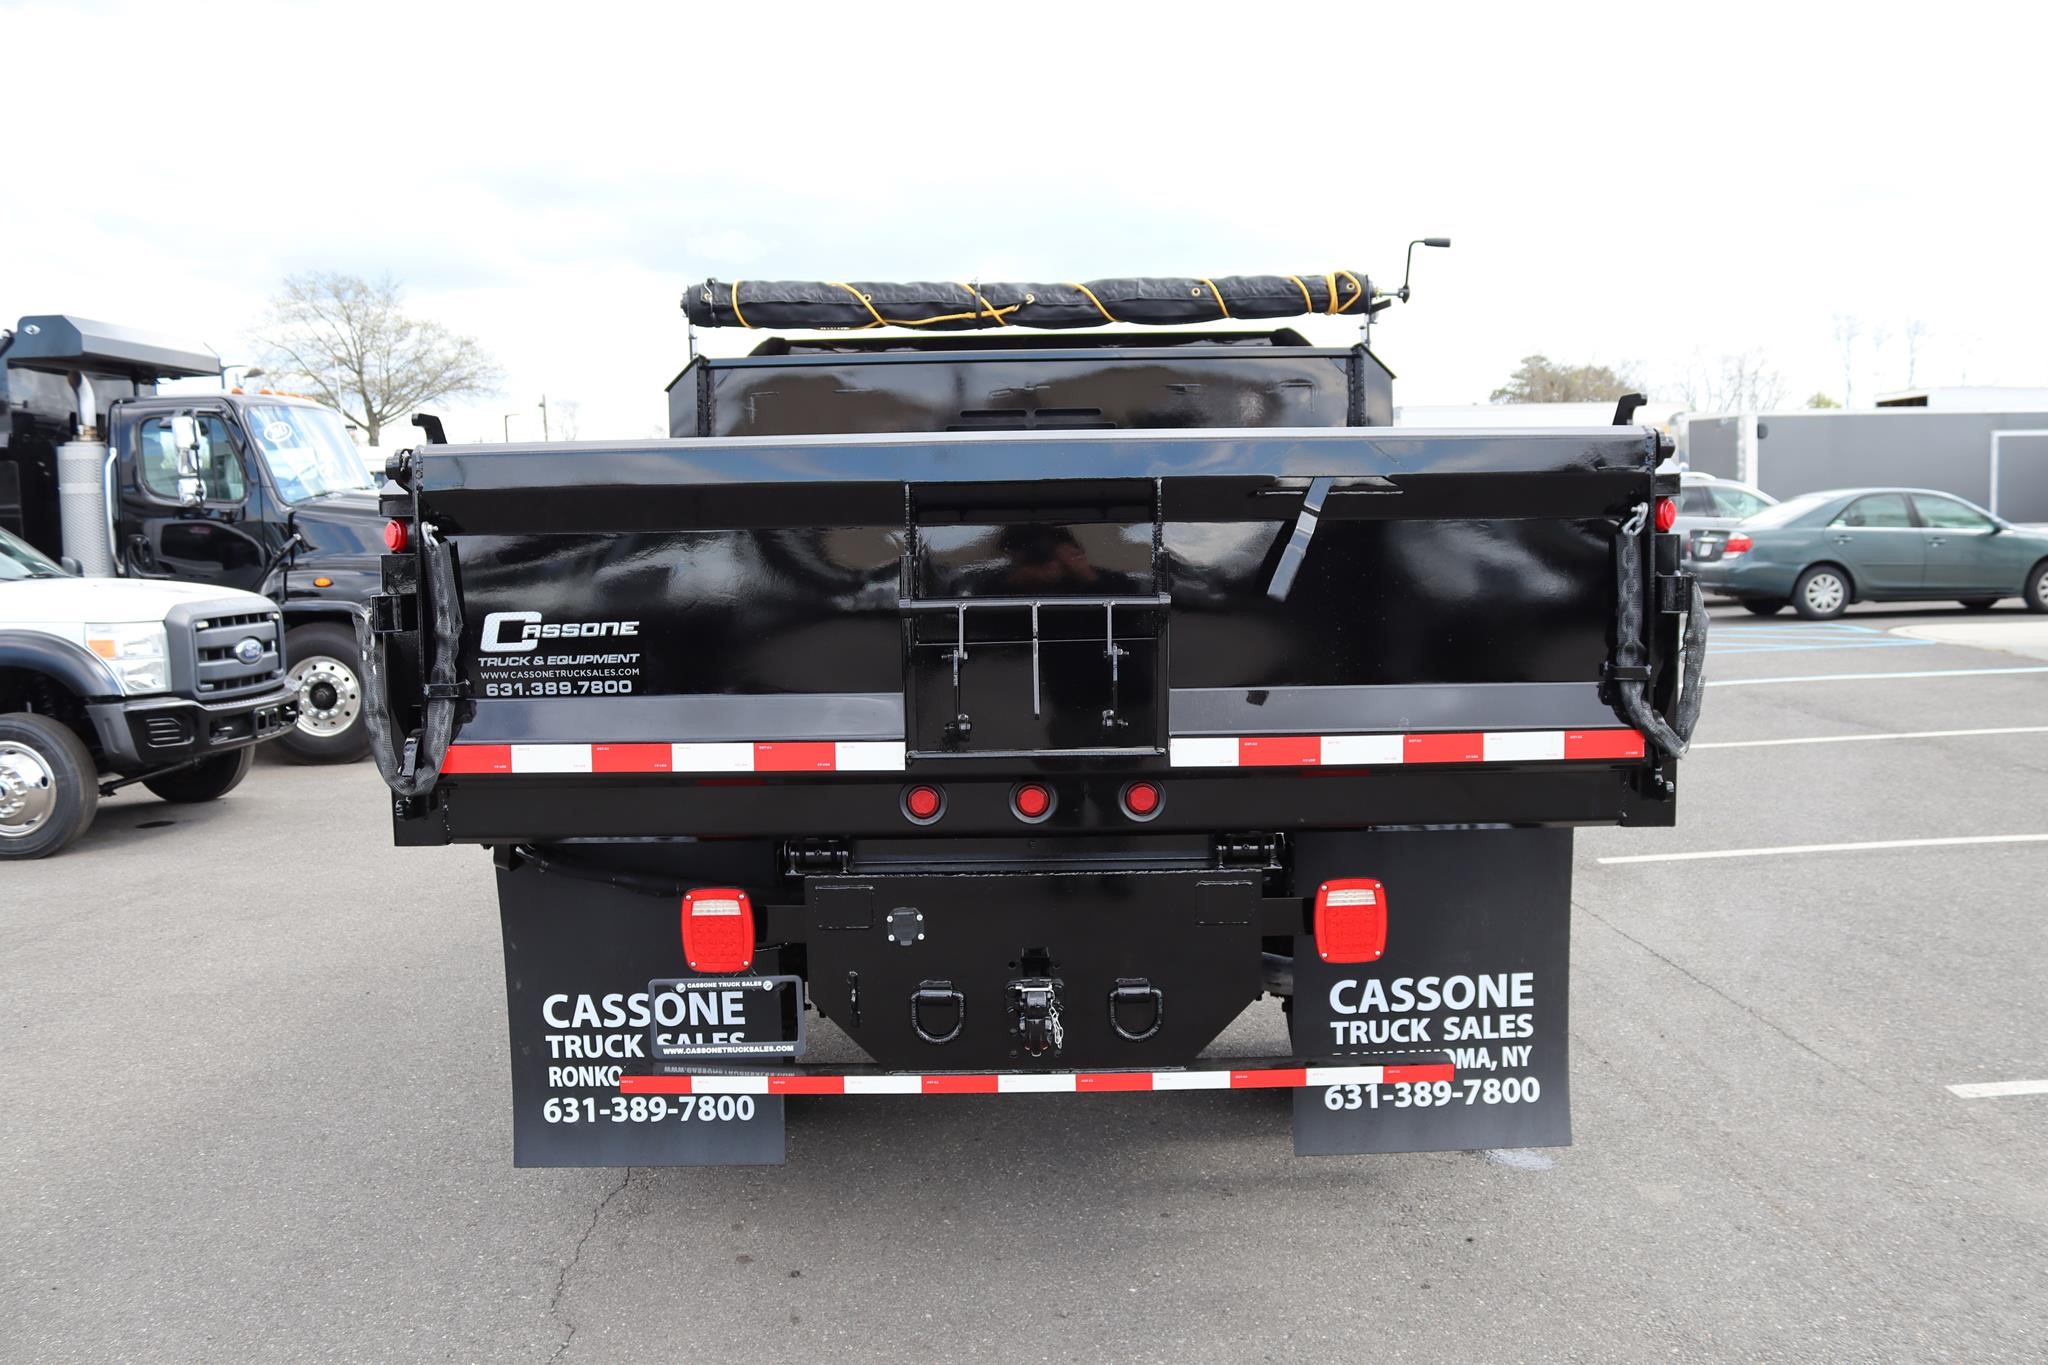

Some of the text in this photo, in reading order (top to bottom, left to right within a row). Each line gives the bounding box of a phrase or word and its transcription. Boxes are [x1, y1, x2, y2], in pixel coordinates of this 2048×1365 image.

[478, 653, 640, 667] TRUCK & EQUIPMENT
[481, 668, 640, 680] WWWCASSONETRUCKSALES.COM
[486, 680, 632, 697] 631.389.7800
[1329, 972, 1534, 1014] CASSONE
[543, 990, 746, 1028] CASSONE
[1330, 1013, 1534, 1045] TRUCK SALES
[545, 1034, 645, 1059] TRUCK
[662, 1045, 794, 1056] WWW.CASSONETRUCKSALES.COM
[1502, 1045, 1533, 1068] NY
[1324, 1076, 1541, 1111] 631-389-7800
[543, 1095, 755, 1123] 631-389-7800
